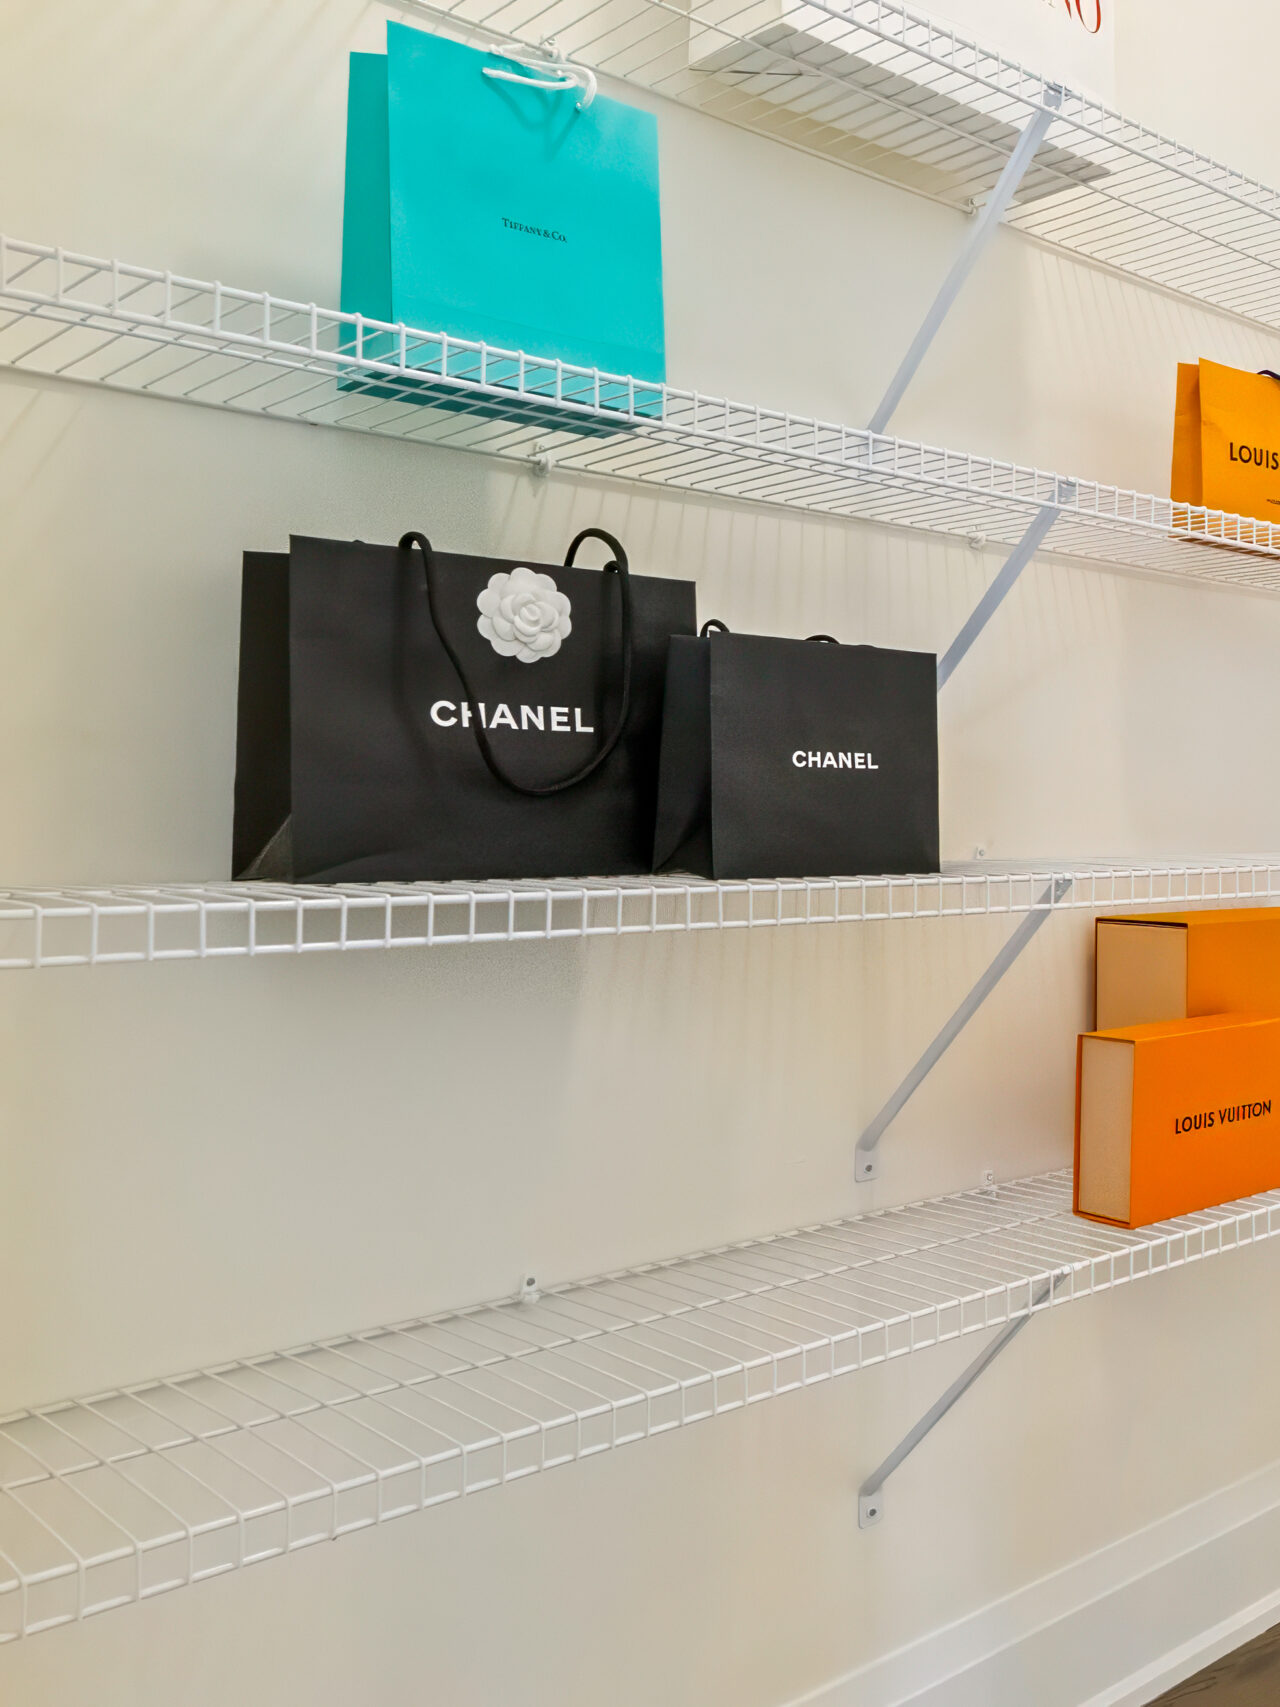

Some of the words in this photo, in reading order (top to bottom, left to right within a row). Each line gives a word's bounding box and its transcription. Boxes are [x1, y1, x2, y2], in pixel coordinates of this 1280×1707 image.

[1229, 442, 1279, 470] LOUIS
[430, 700, 595, 733] CHANEL
[792, 750, 879, 769] CHANEL
[1175, 1111, 1215, 1135] LOUIS
[1218, 1099, 1272, 1125] VUITTON
